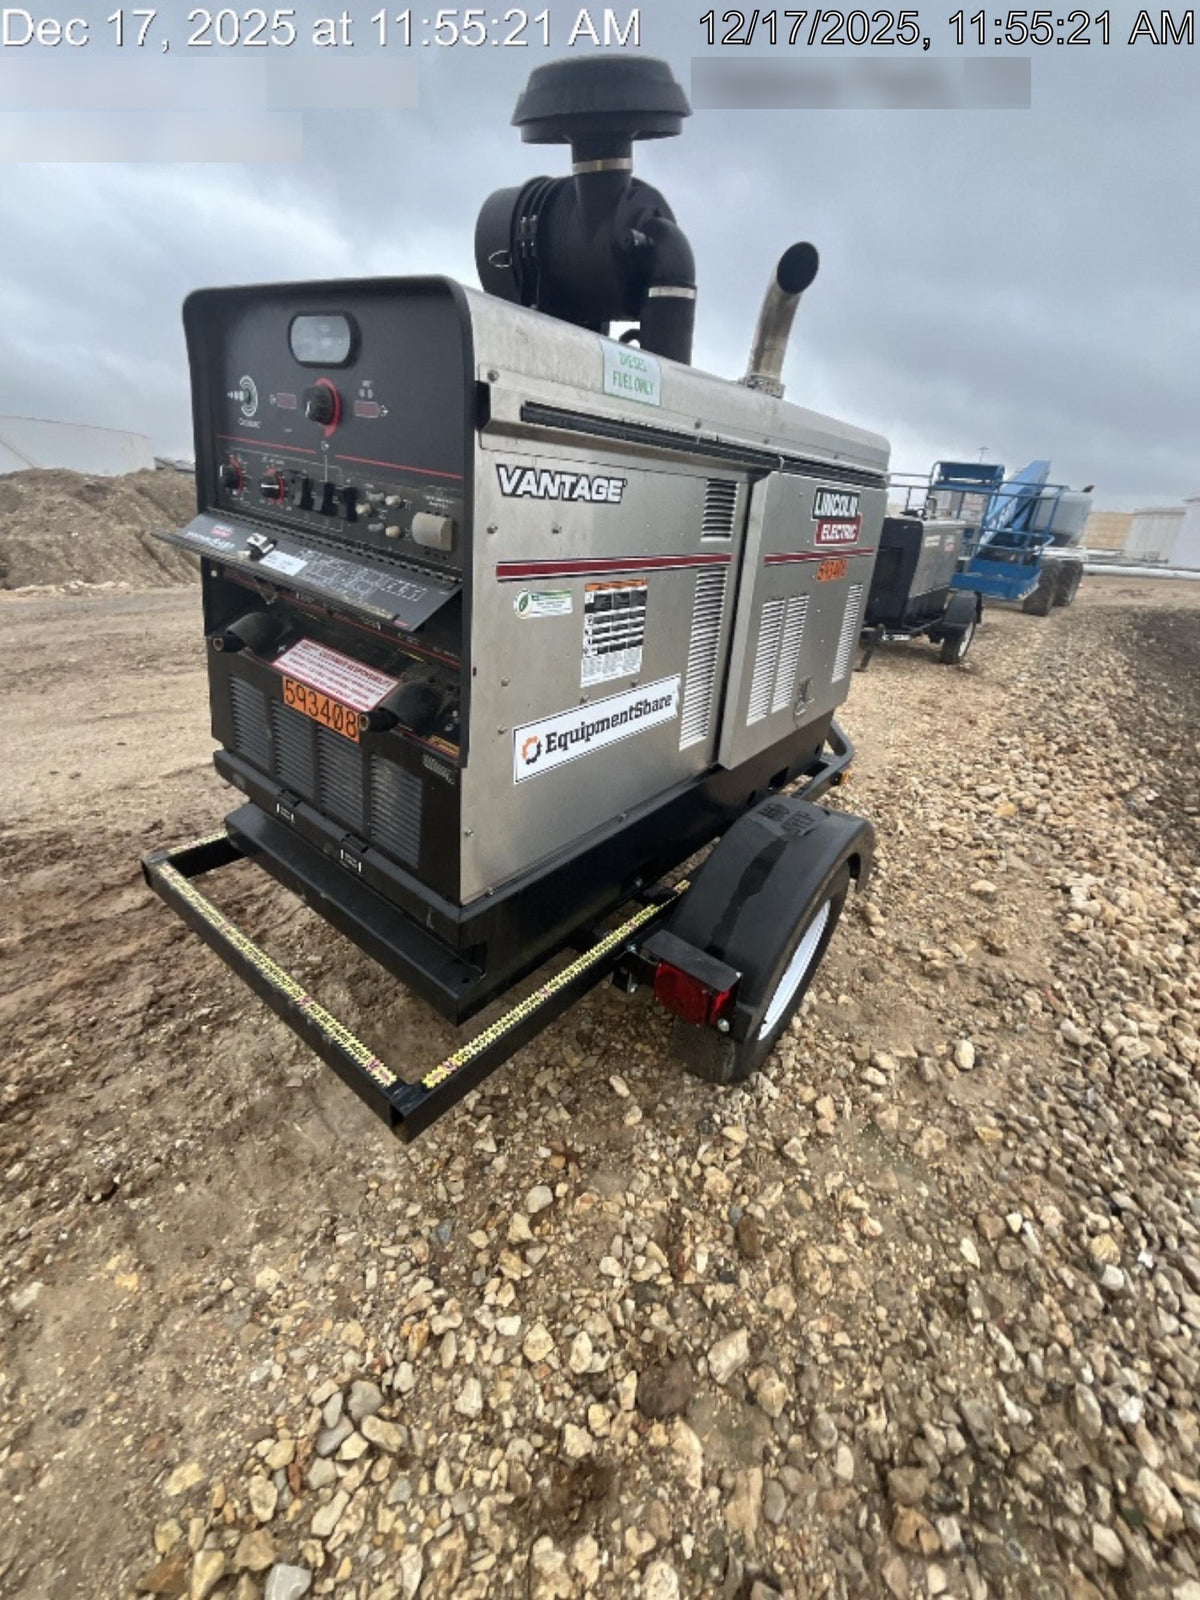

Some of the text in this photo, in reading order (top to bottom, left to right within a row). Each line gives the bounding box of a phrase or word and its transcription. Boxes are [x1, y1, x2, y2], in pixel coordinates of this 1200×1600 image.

[496, 464, 625, 504] VANTAGE
[814, 492, 857, 518] LINCOLN
[821, 523, 857, 541] ELECTRIC
[284, 679, 358, 739] 593408
[545, 694, 674, 755] EquipmentShare
